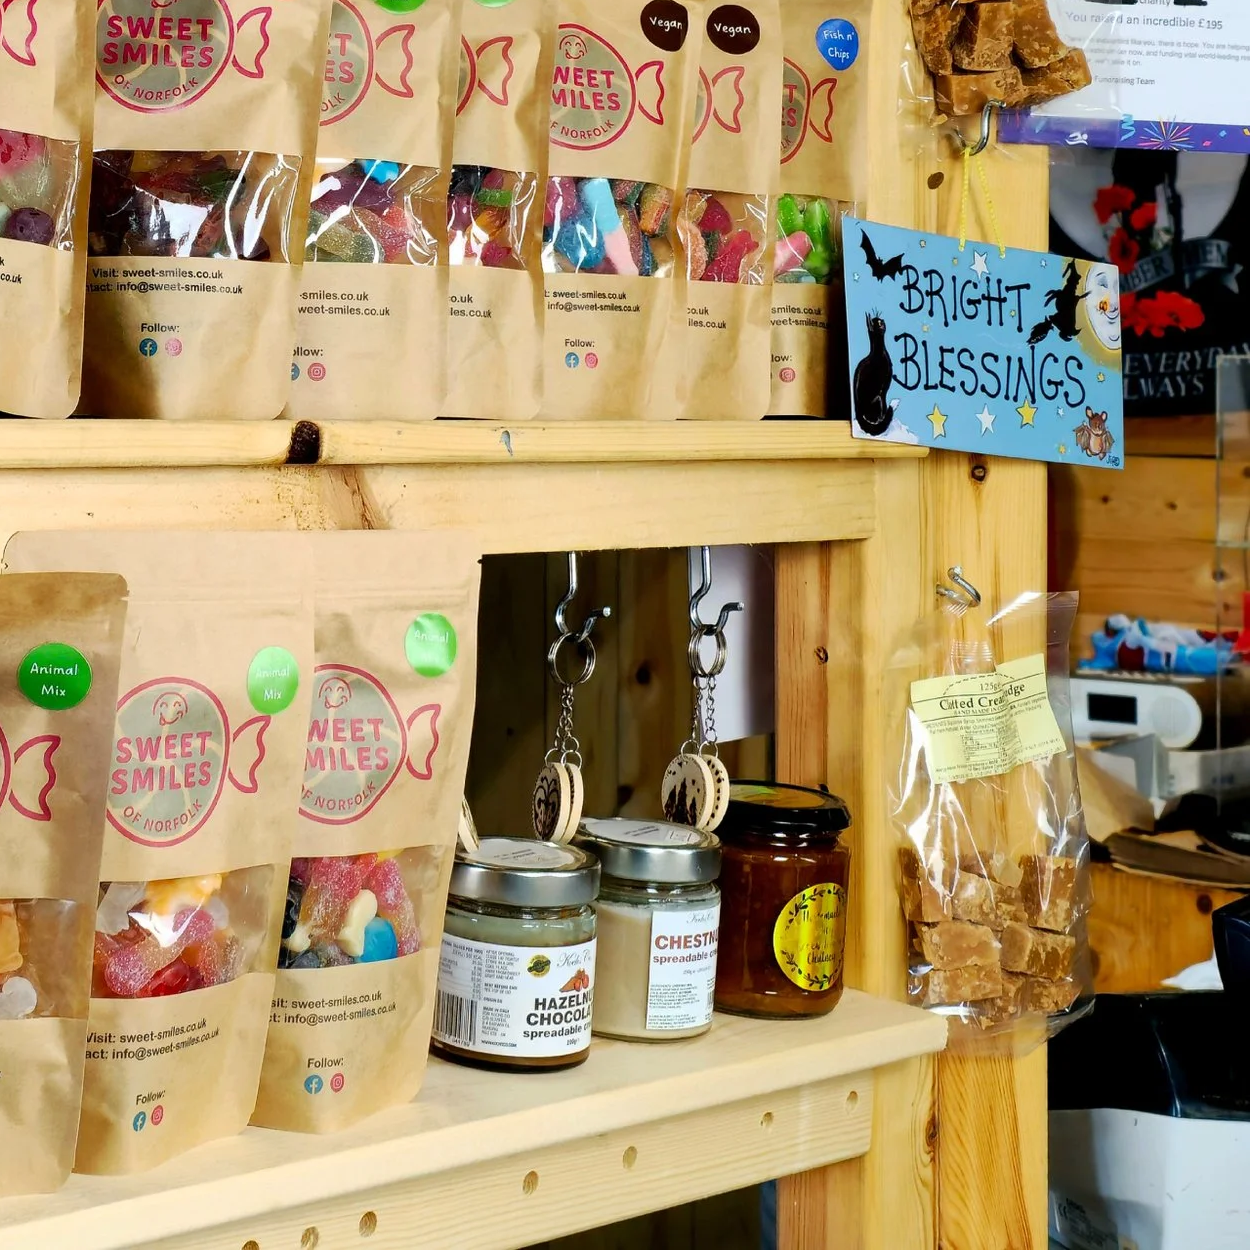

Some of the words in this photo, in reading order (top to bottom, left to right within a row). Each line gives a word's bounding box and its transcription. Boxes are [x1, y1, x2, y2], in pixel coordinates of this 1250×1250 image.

[649, 16, 682, 31] Vegan
[1066, 11, 1087, 23] You
[1090, 12, 1123, 24] raised
[1126, 16, 1139, 25] an
[1143, 14, 1196, 28] incredible
[107, 15, 213, 42] SWEET
[713, 22, 751, 37] Vegan
[824, 30, 844, 41] Fish
[103, 42, 214, 68] SMILES
[828, 47, 850, 61] Chips
[133, 77, 198, 101] NORFOLK
[560, 120, 615, 140] NORFOLK
[92, 268, 119, 279] Visit:
[122, 268, 223, 280] sweet-smiles.co.uk
[116, 281, 243, 295] info@sweet-smiles.co.uk
[552, 290, 627, 300] sweet-smiles.co.uk
[898, 264, 1031, 333] BRIGHT
[547, 301, 641, 313] info@sweet-smiles.co.uk
[141, 323, 180, 334] Follow:
[564, 339, 595, 348] Follow:
[892, 332, 1086, 408] BLESSINGS
[30, 662, 79, 677] Animal
[41, 683, 66, 697] Mix
[263, 689, 283, 701] Mix
[115, 731, 213, 763] SWEET
[111, 761, 212, 795] SMILES
[314, 780, 375, 811] NORFOLK
[123, 805, 141, 824] OF
[143, 798, 202, 832] NORFOLK
[653, 951, 708, 965] spreadable
[291, 990, 382, 1010] sweet-smiles.co.uk
[284, 1002, 397, 1026] info@sweet-smiles.co.uk
[86, 1032, 117, 1044] Visit:
[119, 1018, 207, 1043] sweet-smiles.co.uk
[523, 1025, 582, 1040] spreadable
[112, 1027, 220, 1060] info@sweet-smiles.co.uk
[307, 1057, 344, 1069] Follow:
[136, 1090, 166, 1106] Follow:
